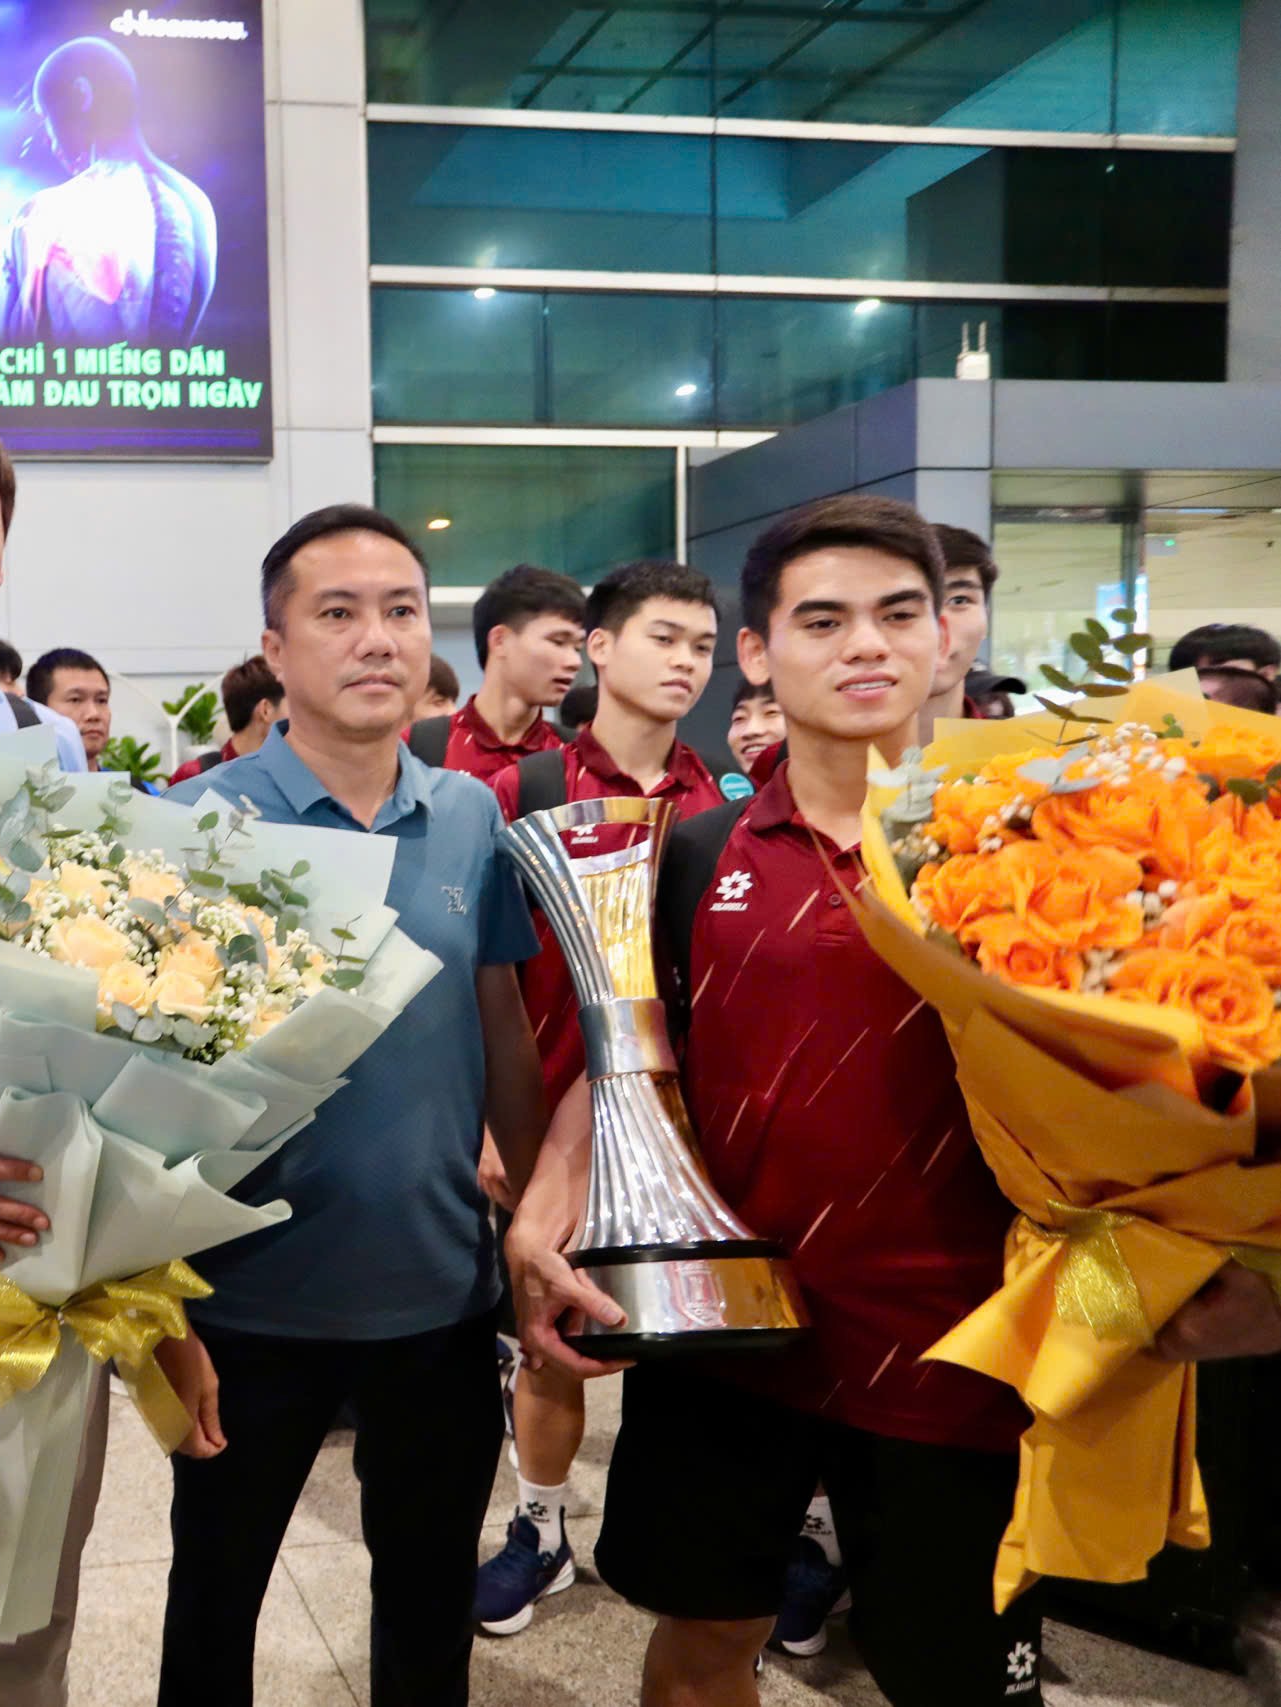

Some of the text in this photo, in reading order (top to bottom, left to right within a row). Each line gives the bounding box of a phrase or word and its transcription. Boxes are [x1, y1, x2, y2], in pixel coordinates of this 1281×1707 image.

[53, 348, 67, 374] 1
[75, 341, 162, 375] MIẾNG
[170, 345, 226, 376] DÁN
[44, 379, 101, 407] ĐAU
[107, 380, 182, 411] TRỌN
[189, 377, 263, 408] NGÀY
